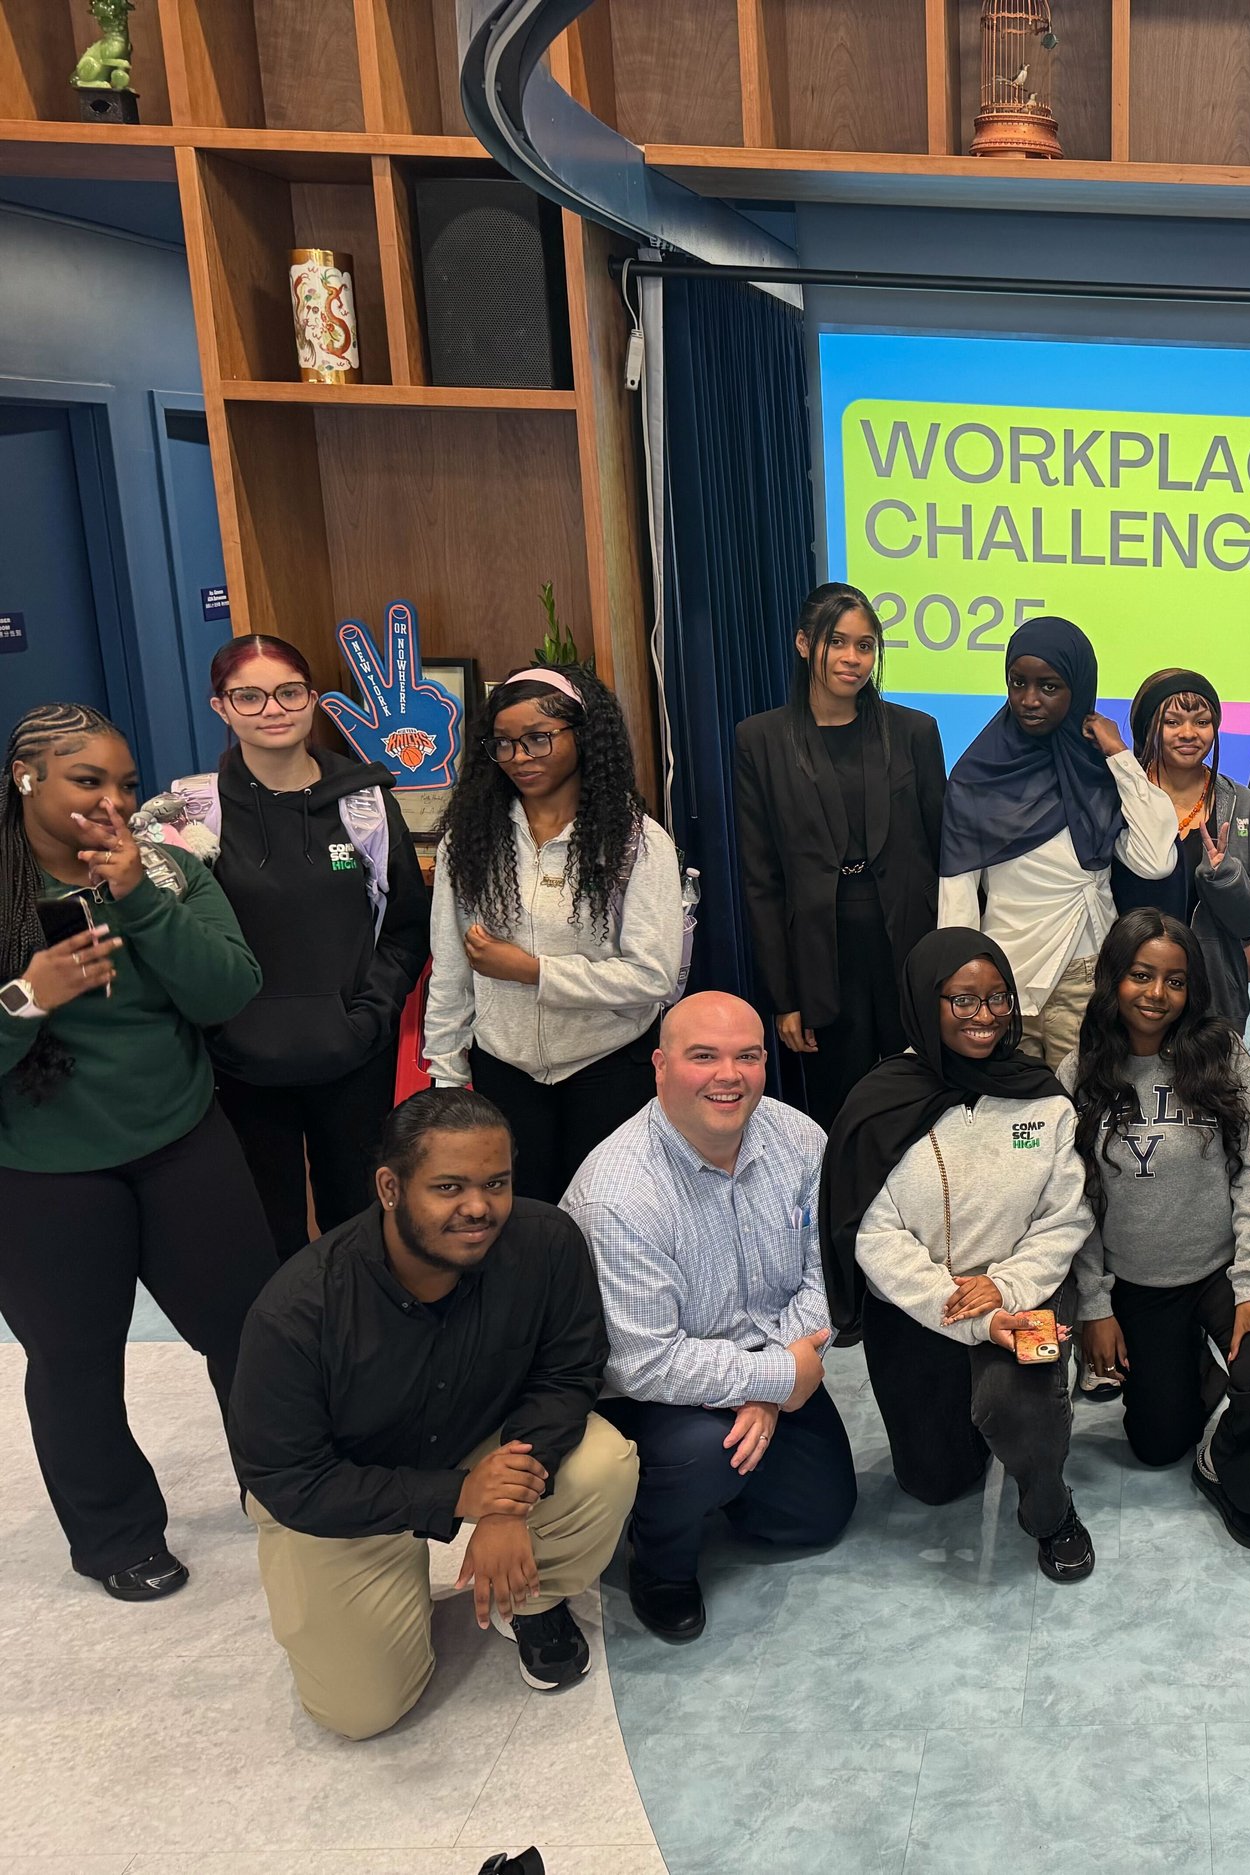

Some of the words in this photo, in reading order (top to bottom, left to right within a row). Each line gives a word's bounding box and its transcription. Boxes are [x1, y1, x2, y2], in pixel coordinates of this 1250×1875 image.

[394, 622, 407, 635] OR
[351, 641, 371, 674] NEW
[367, 674, 392, 717] YORK
[397, 638, 407, 714] NOWHERE
[387, 731, 435, 752] KNICKS
[1101, 1084, 1219, 1129] AL
[1012, 1121, 1046, 1131] COMP
[1012, 1138, 1041, 1149] HIGH
[1120, 1134, 1166, 1179] Y
